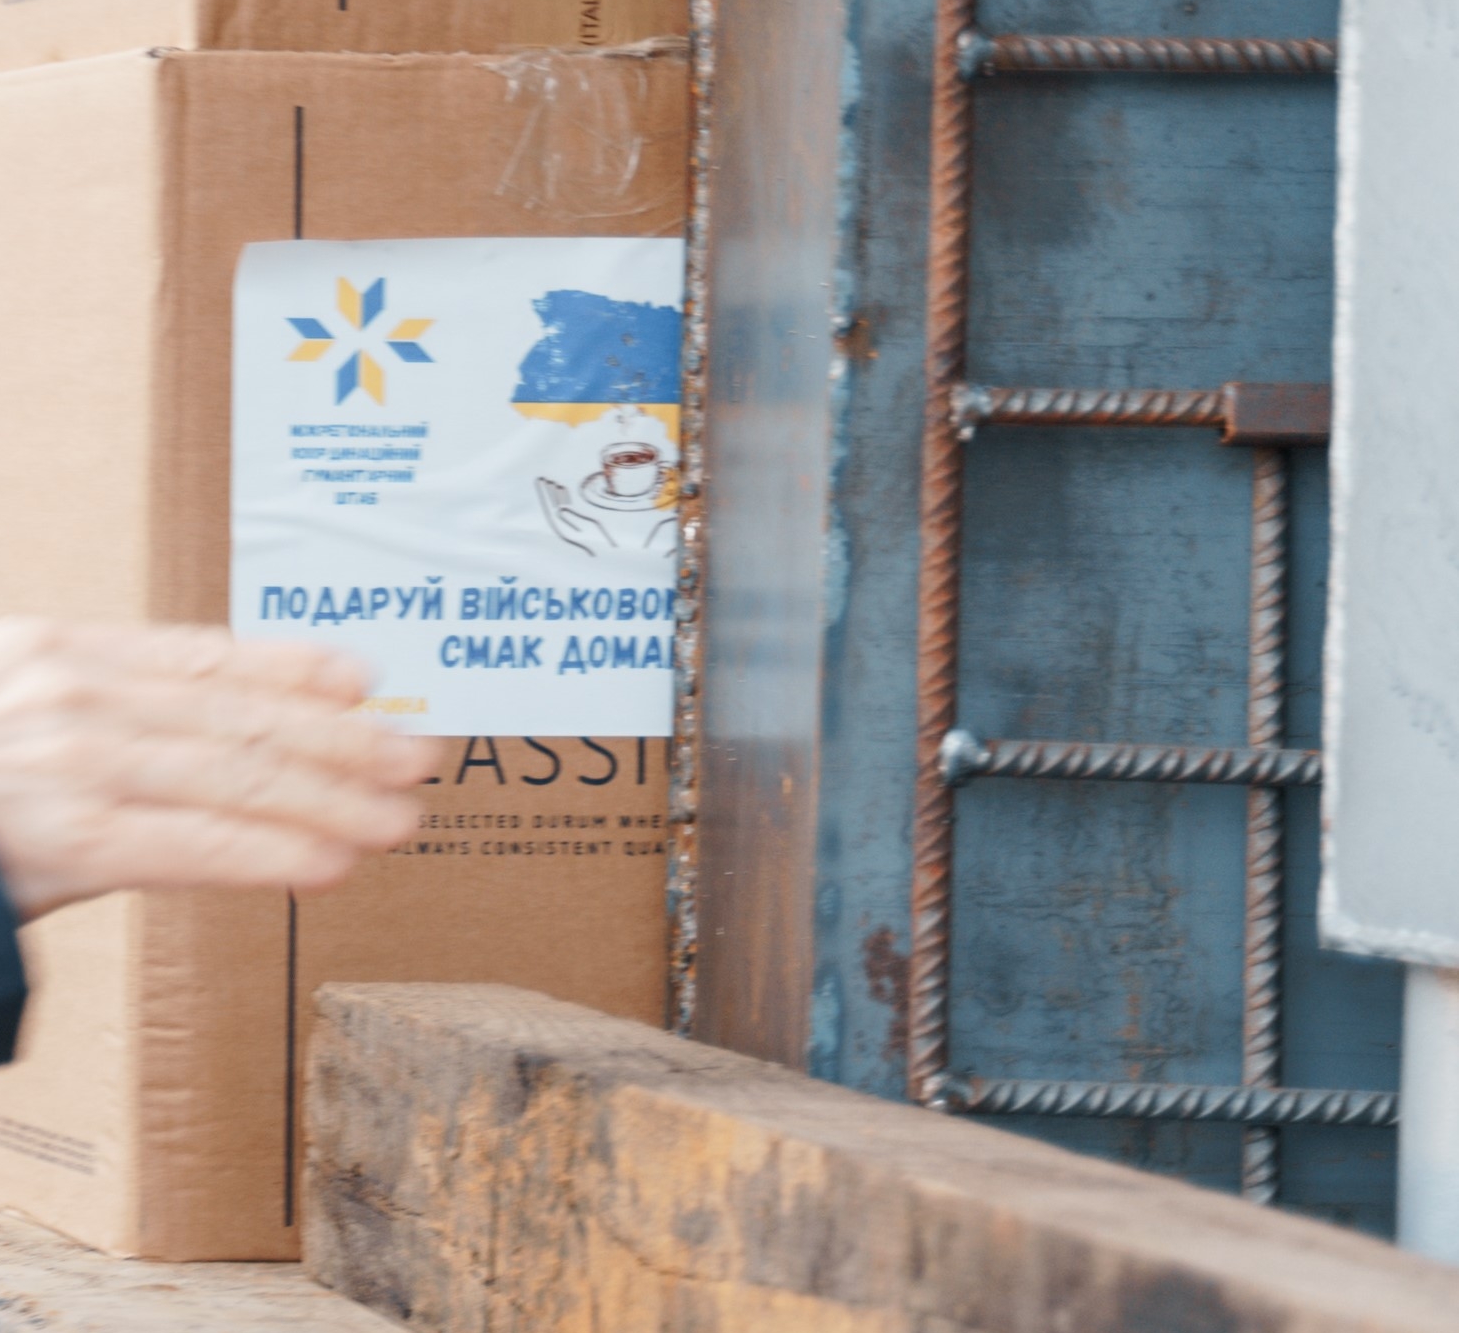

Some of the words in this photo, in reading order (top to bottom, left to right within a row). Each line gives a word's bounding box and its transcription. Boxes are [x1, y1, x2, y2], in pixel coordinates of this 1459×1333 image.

[260, 576, 444, 626] ПОДАРУЙ
[440, 634, 544, 669] СМАК
[556, 634, 675, 674] ДОМА
[418, 815, 521, 829] SELECTED
[533, 815, 606, 829] DURUM
[482, 841, 613, 856] CONSISTENT
